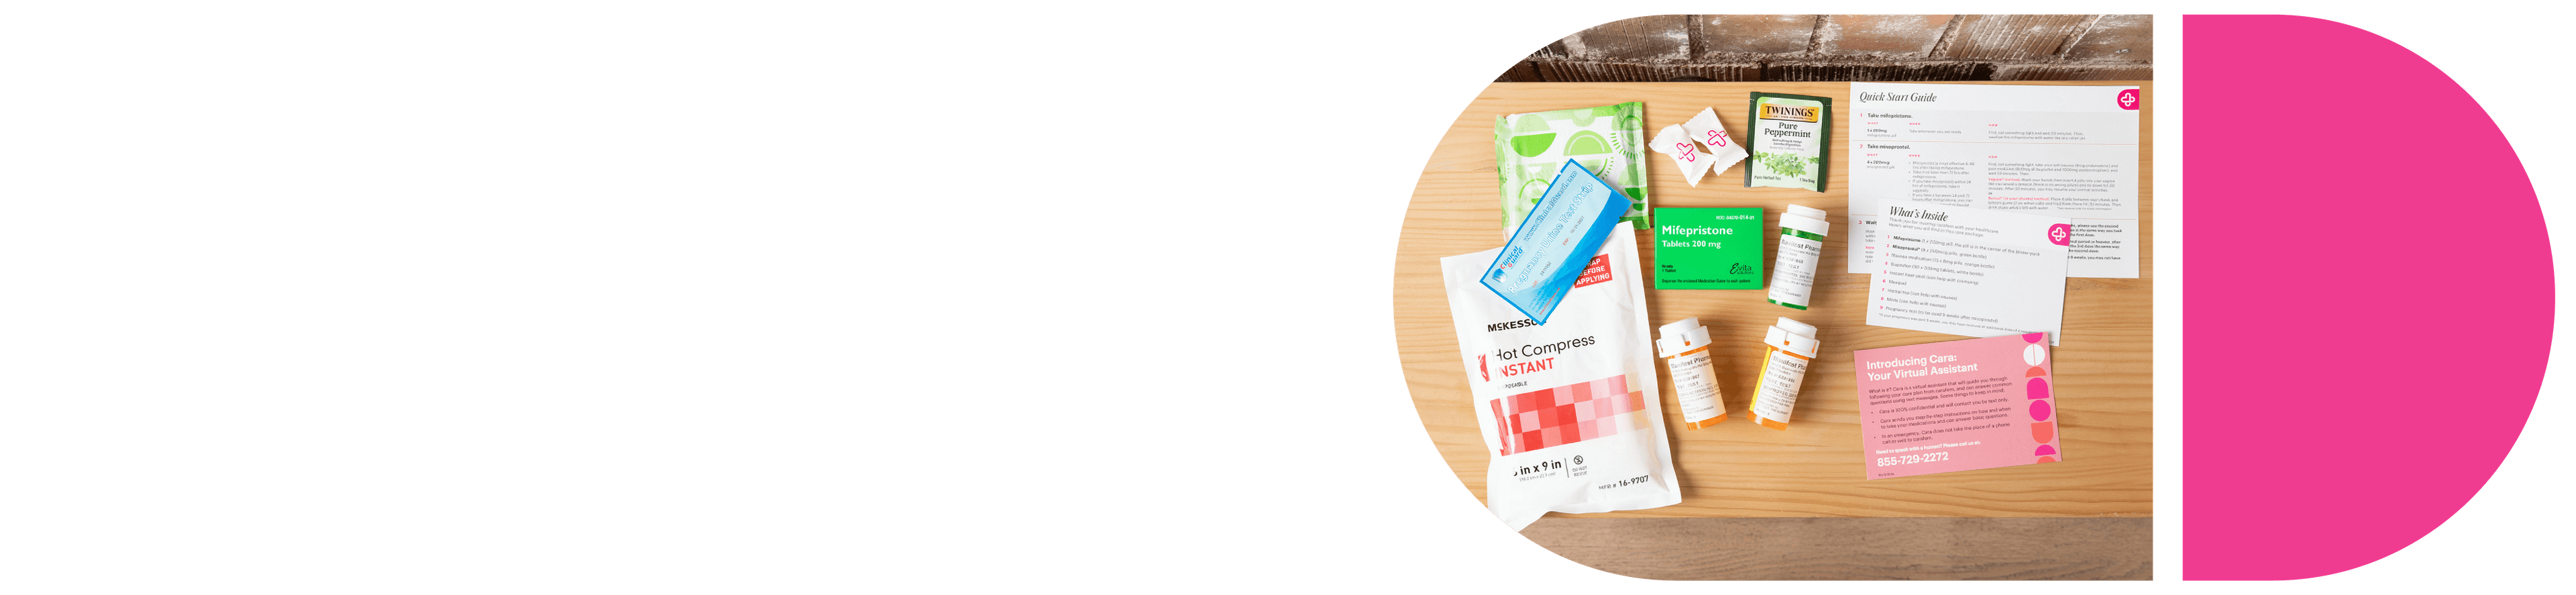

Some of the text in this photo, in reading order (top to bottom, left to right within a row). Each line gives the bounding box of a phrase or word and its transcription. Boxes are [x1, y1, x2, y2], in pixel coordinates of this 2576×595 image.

[1860, 92, 1937, 103] Quick Start Guide
[1766, 106, 1813, 117] TWININGS
[1765, 128, 1811, 138] Peppermint
[1890, 206, 1948, 222] What's Inside
[1662, 225, 1733, 237] Mifepristone
[1507, 247, 1544, 296] Pregnancy
[1541, 223, 1563, 247] Urine
[1558, 204, 1577, 223] Test
[1573, 182, 1593, 205] Strip
[1500, 246, 1518, 269] Clinical
[1508, 247, 1523, 267] Guard
[1730, 263, 1752, 274] Evita
[1577, 273, 1609, 285] APPLYING
[1488, 319, 1547, 332] McKESSO
[1522, 336, 1595, 357] Compress
[1867, 355, 1956, 369] Introducing Cara:
[1867, 364, 1977, 380] Your Virtual Assistant
[1878, 452, 1948, 466] 855-729-2272
[1520, 466, 1531, 475] in
[1542, 462, 1548, 471] 9
[1551, 460, 1562, 469] in
[1618, 475, 1649, 487] 16-9707
